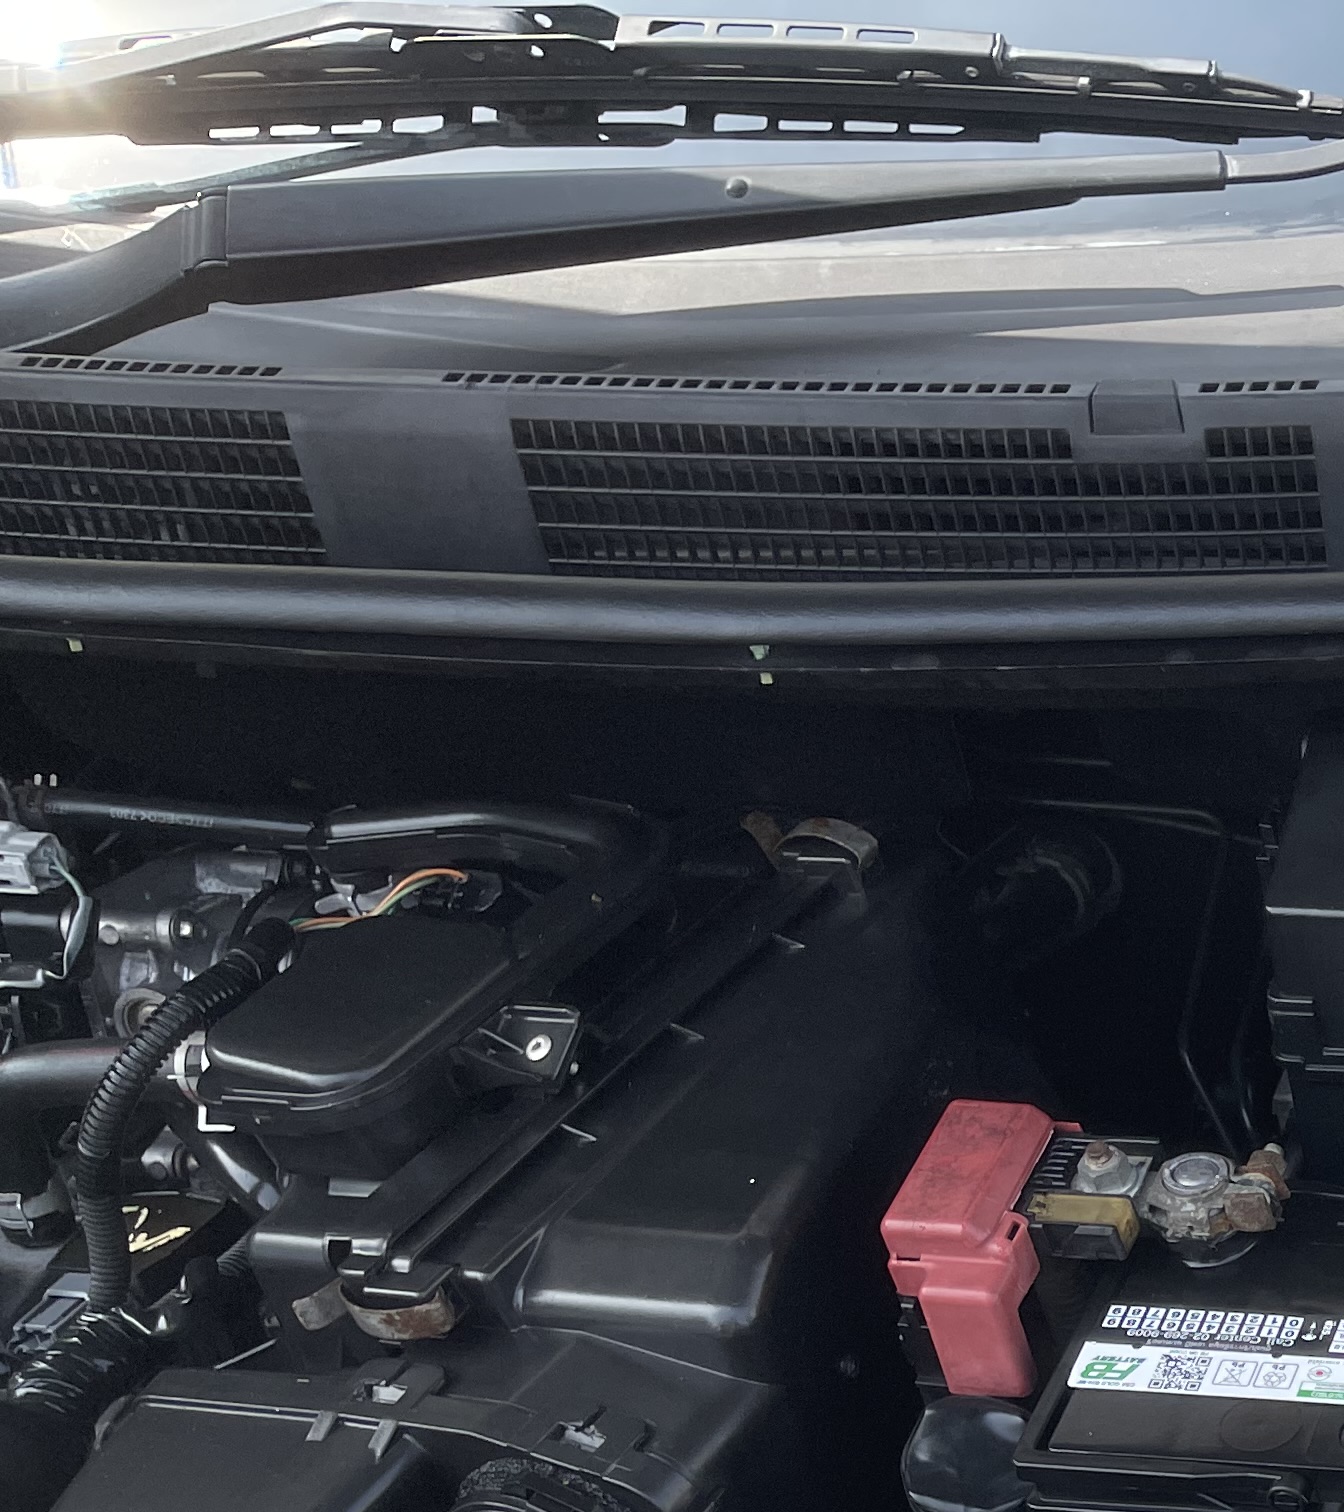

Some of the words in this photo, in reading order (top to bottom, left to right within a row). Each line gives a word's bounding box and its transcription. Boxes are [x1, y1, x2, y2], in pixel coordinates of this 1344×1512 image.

[1214, 1334, 1262, 1345] Center
[1267, 1337, 1294, 1346] Call
[1080, 1361, 1140, 1381] FB
